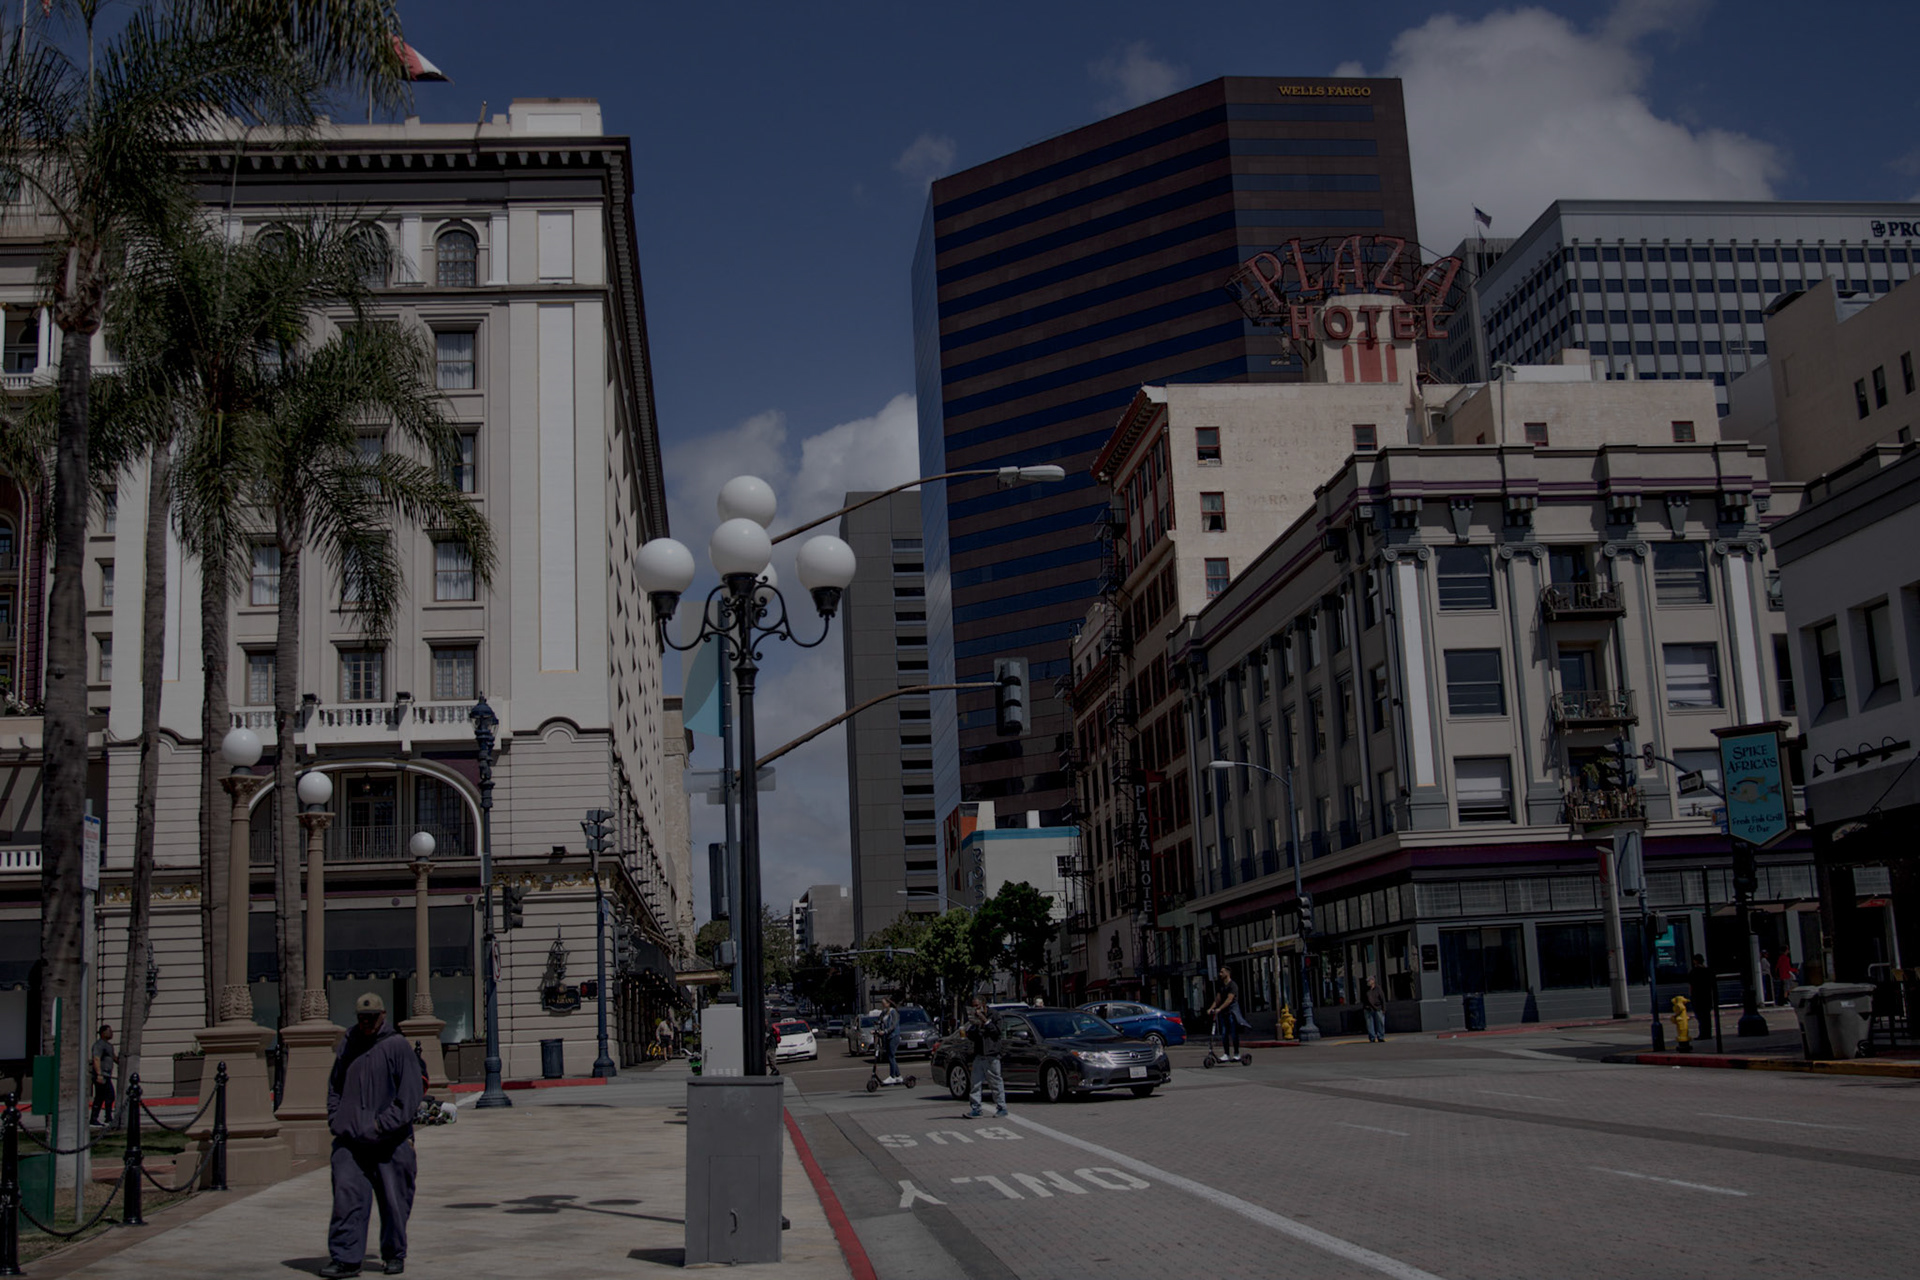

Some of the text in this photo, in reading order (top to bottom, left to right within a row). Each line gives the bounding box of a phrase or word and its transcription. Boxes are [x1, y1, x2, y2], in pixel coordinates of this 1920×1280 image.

[1278, 86, 1371, 97] WELLS FARGO
[1244, 234, 1463, 306] PLAZA
[1290, 304, 1449, 340] HOTEL
[1727, 757, 1777, 774] AFRICA'S
[1732, 745, 1767, 759] SPIKE
[1134, 785, 1150, 850] PLAZA
[877, 1126, 1025, 1148] BUS
[898, 1167, 1151, 1208] ONLY
